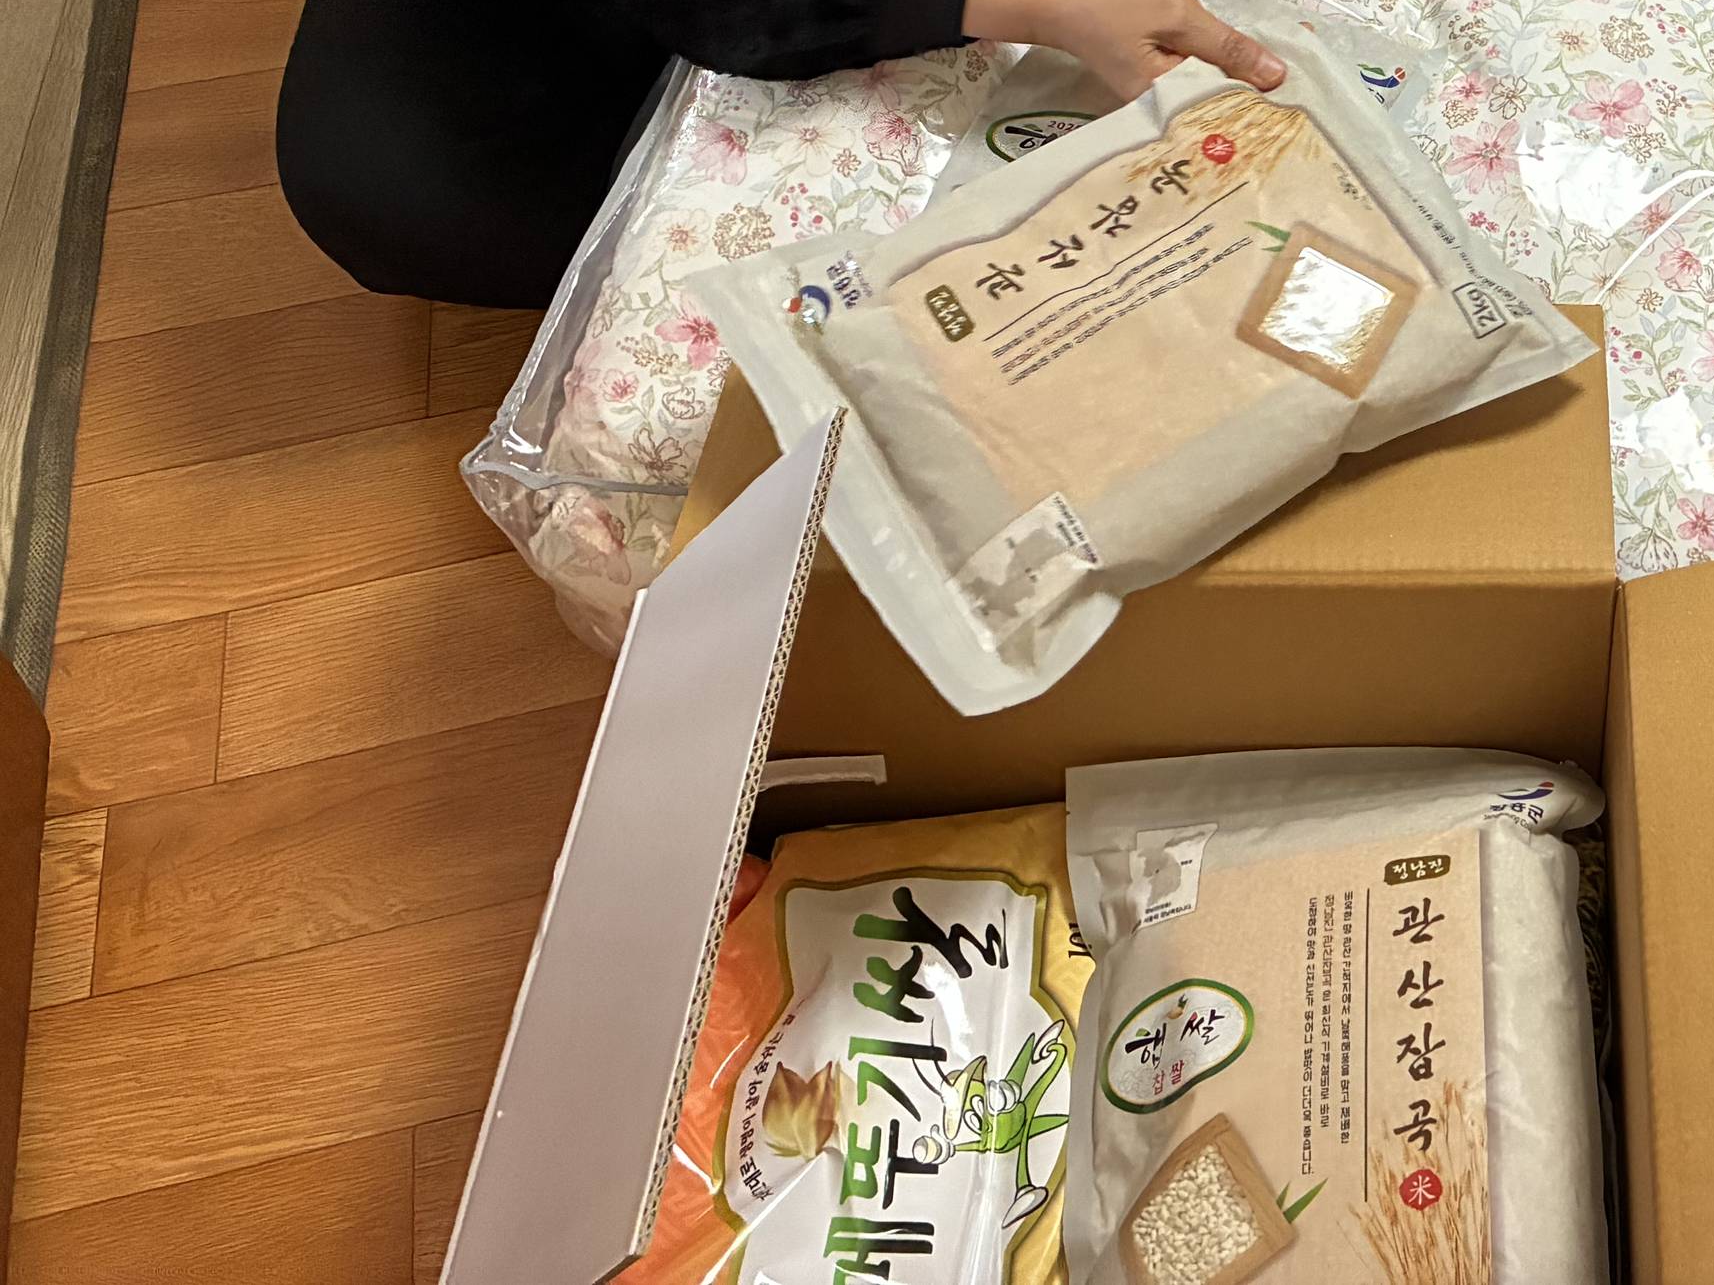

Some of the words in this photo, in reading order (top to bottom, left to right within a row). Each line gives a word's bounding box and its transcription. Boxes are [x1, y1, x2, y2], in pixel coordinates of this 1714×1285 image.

[1047, 120, 1084, 133] 202
[975, 159, 1192, 301] 관산잡곡
[1467, 288, 1498, 327] 2kg
[1392, 858, 1444, 881] 정남진
[1392, 897, 1447, 1152] 관산잡곡
[745, 1080, 763, 1111] 살아
[1408, 1174, 1437, 1206] 米
